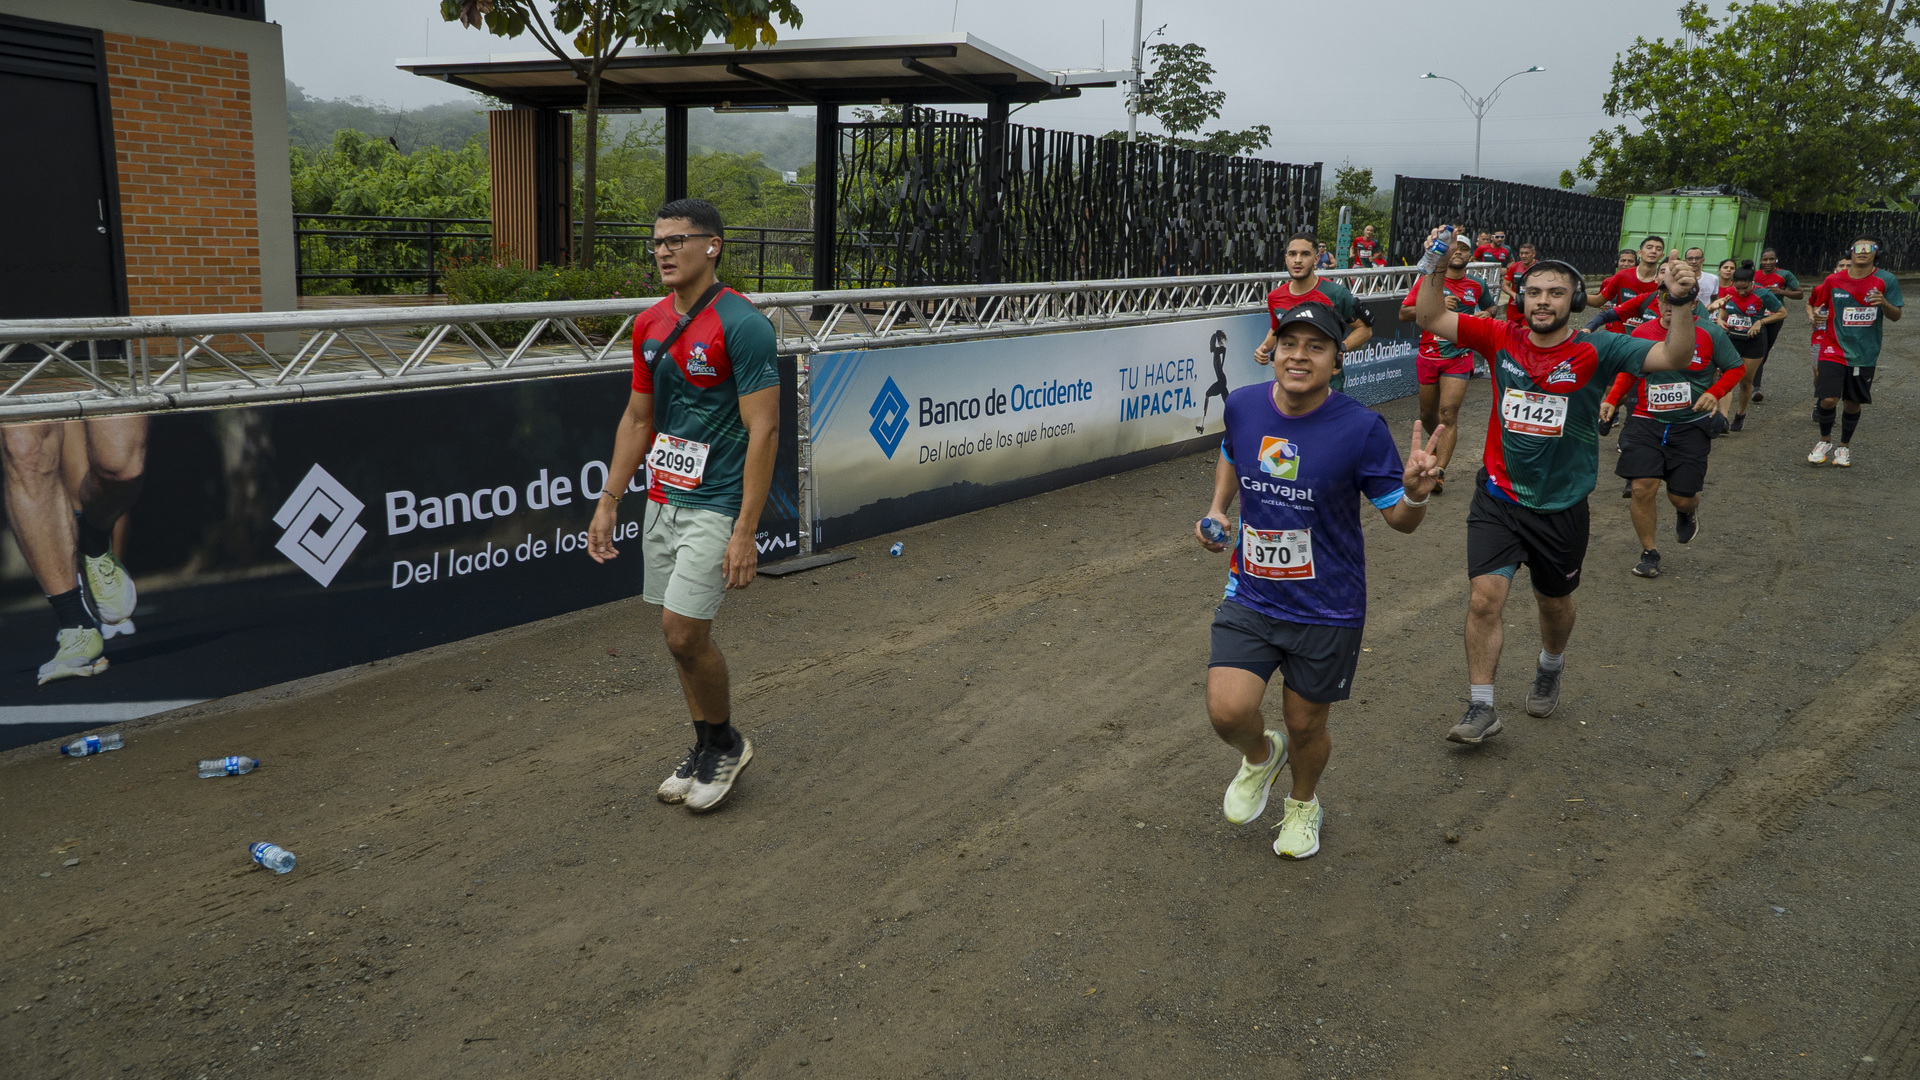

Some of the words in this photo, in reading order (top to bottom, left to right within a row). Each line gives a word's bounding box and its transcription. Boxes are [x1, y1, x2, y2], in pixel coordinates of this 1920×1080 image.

[1365, 343, 1374, 363] de
[1375, 340, 1411, 360] Occidente
[1119, 366, 1138, 391] TU
[1145, 358, 1197, 382] HACER,
[1360, 372, 1367, 384] de
[1376, 372, 1386, 383] que
[919, 397, 980, 427] Banco
[985, 388, 1007, 416] de
[1011, 379, 1092, 412] Occidente
[1120, 387, 1196, 422] IMPACTA.
[1653, 391, 1683, 403] 2069
[1512, 403, 1554, 424] 1142
[919, 441, 942, 464] Del
[945, 437, 974, 459] lado
[977, 433, 992, 452] de
[996, 430, 1012, 448] los
[1016, 429, 1037, 448] que
[1040, 422, 1076, 440] hacen.
[656, 449, 695, 474] 2099
[385, 485, 517, 536] Banco
[526, 468, 572, 510] de
[1240, 476, 1315, 502] Carvajal
[392, 552, 439, 589] Del
[449, 541, 509, 577] lado
[515, 533, 548, 562] de
[555, 527, 588, 554] los
[612, 521, 639, 542] ue
[1255, 545, 1291, 564] 970
